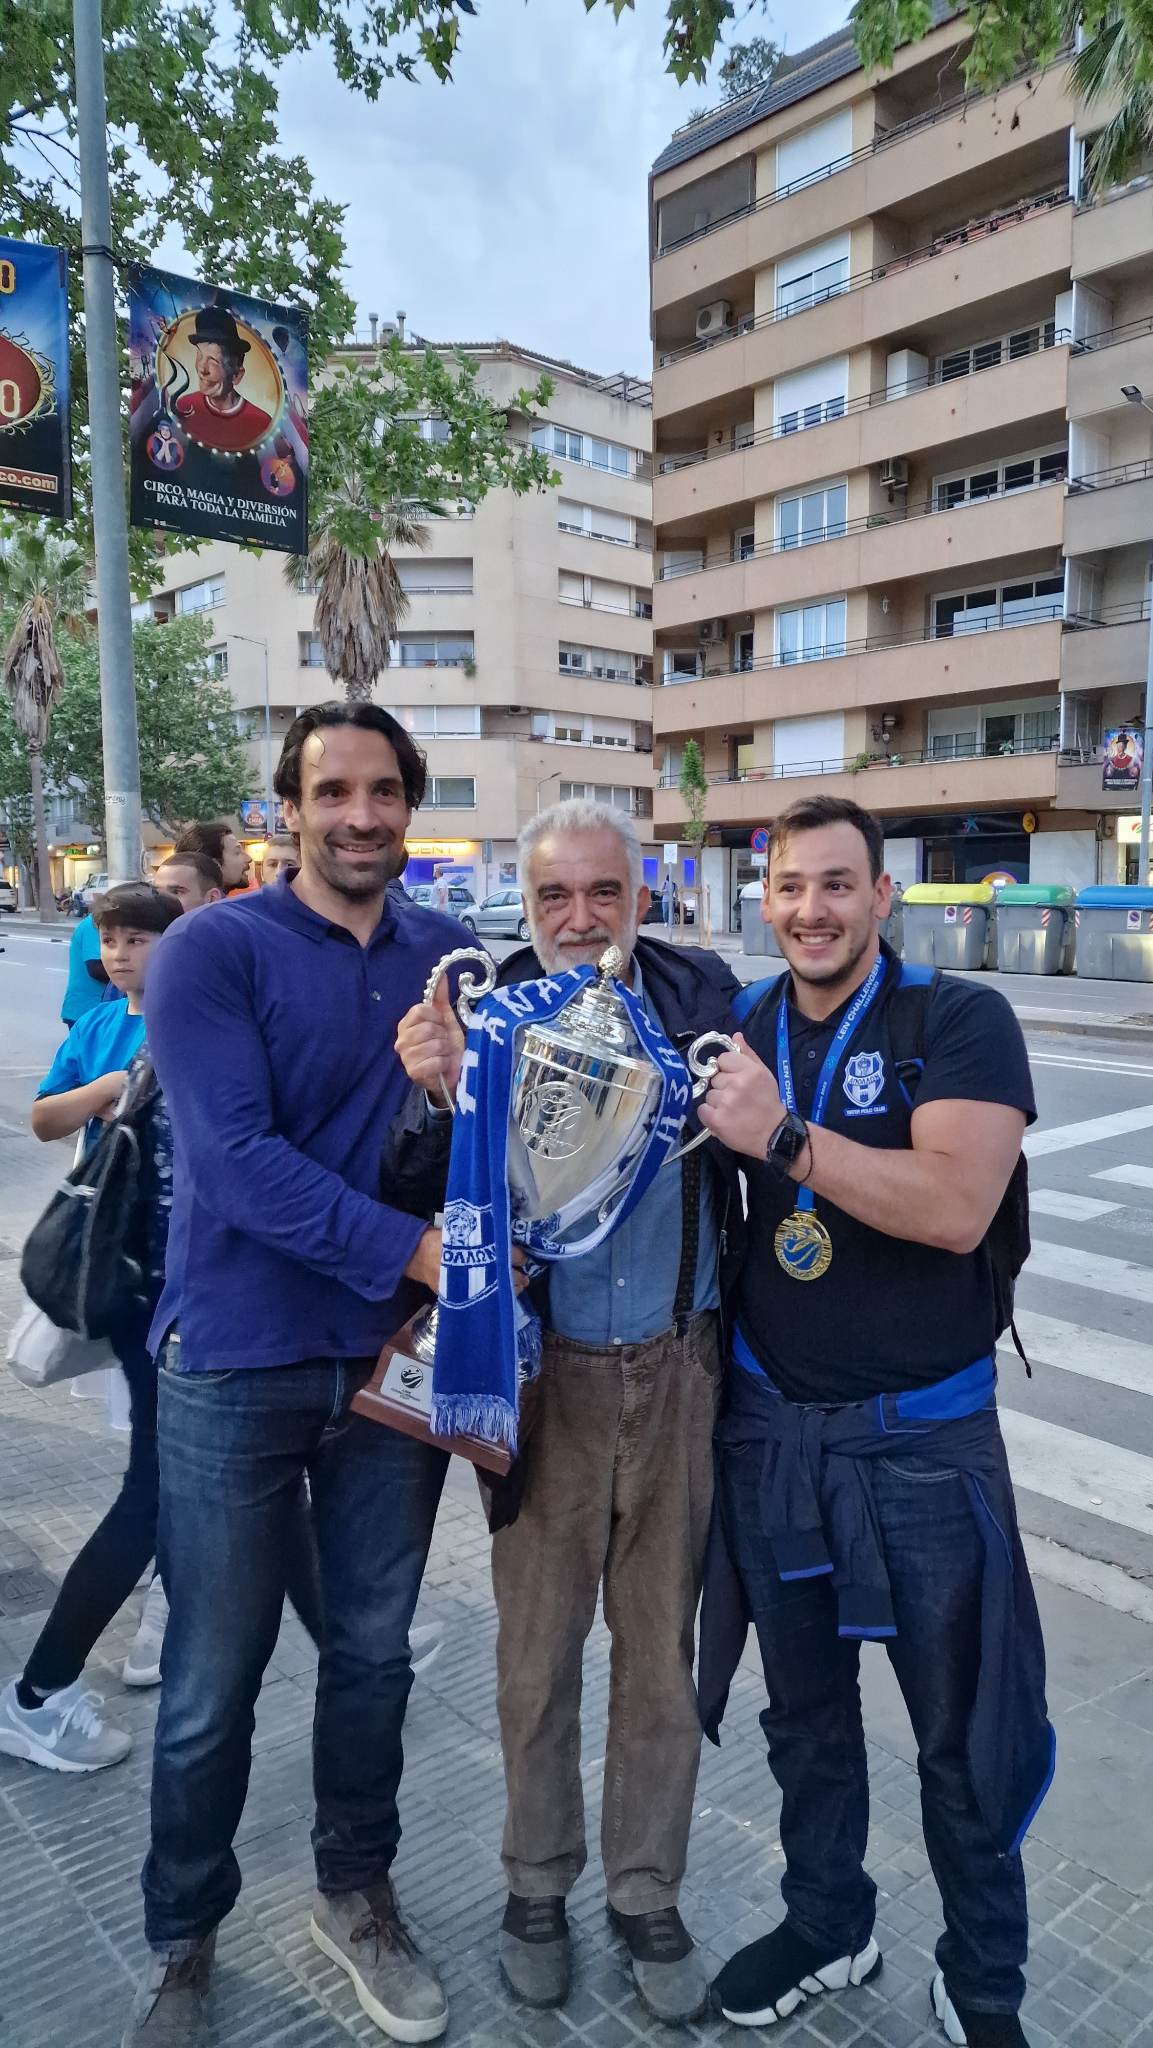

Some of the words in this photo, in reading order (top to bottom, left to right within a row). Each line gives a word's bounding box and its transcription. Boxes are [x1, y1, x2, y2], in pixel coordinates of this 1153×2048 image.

[143, 480, 185, 497] CIRCO,
[187, 488, 226, 505] MAGIA
[227, 497, 235, 507] Y
[237, 499, 297, 519] DIVERSIÓN
[156, 493, 188, 508] PARA
[190, 499, 222, 515] TODA
[225, 507, 239, 518] LA
[241, 509, 287, 527] FAMILIA
[837, 1022, 850, 1040] LEN
[847, 962, 881, 1021] CHALLENGER
[782, 1060, 790, 1078] LEN
[443, 1245, 496, 1263] ΟΛΛΩΝ
